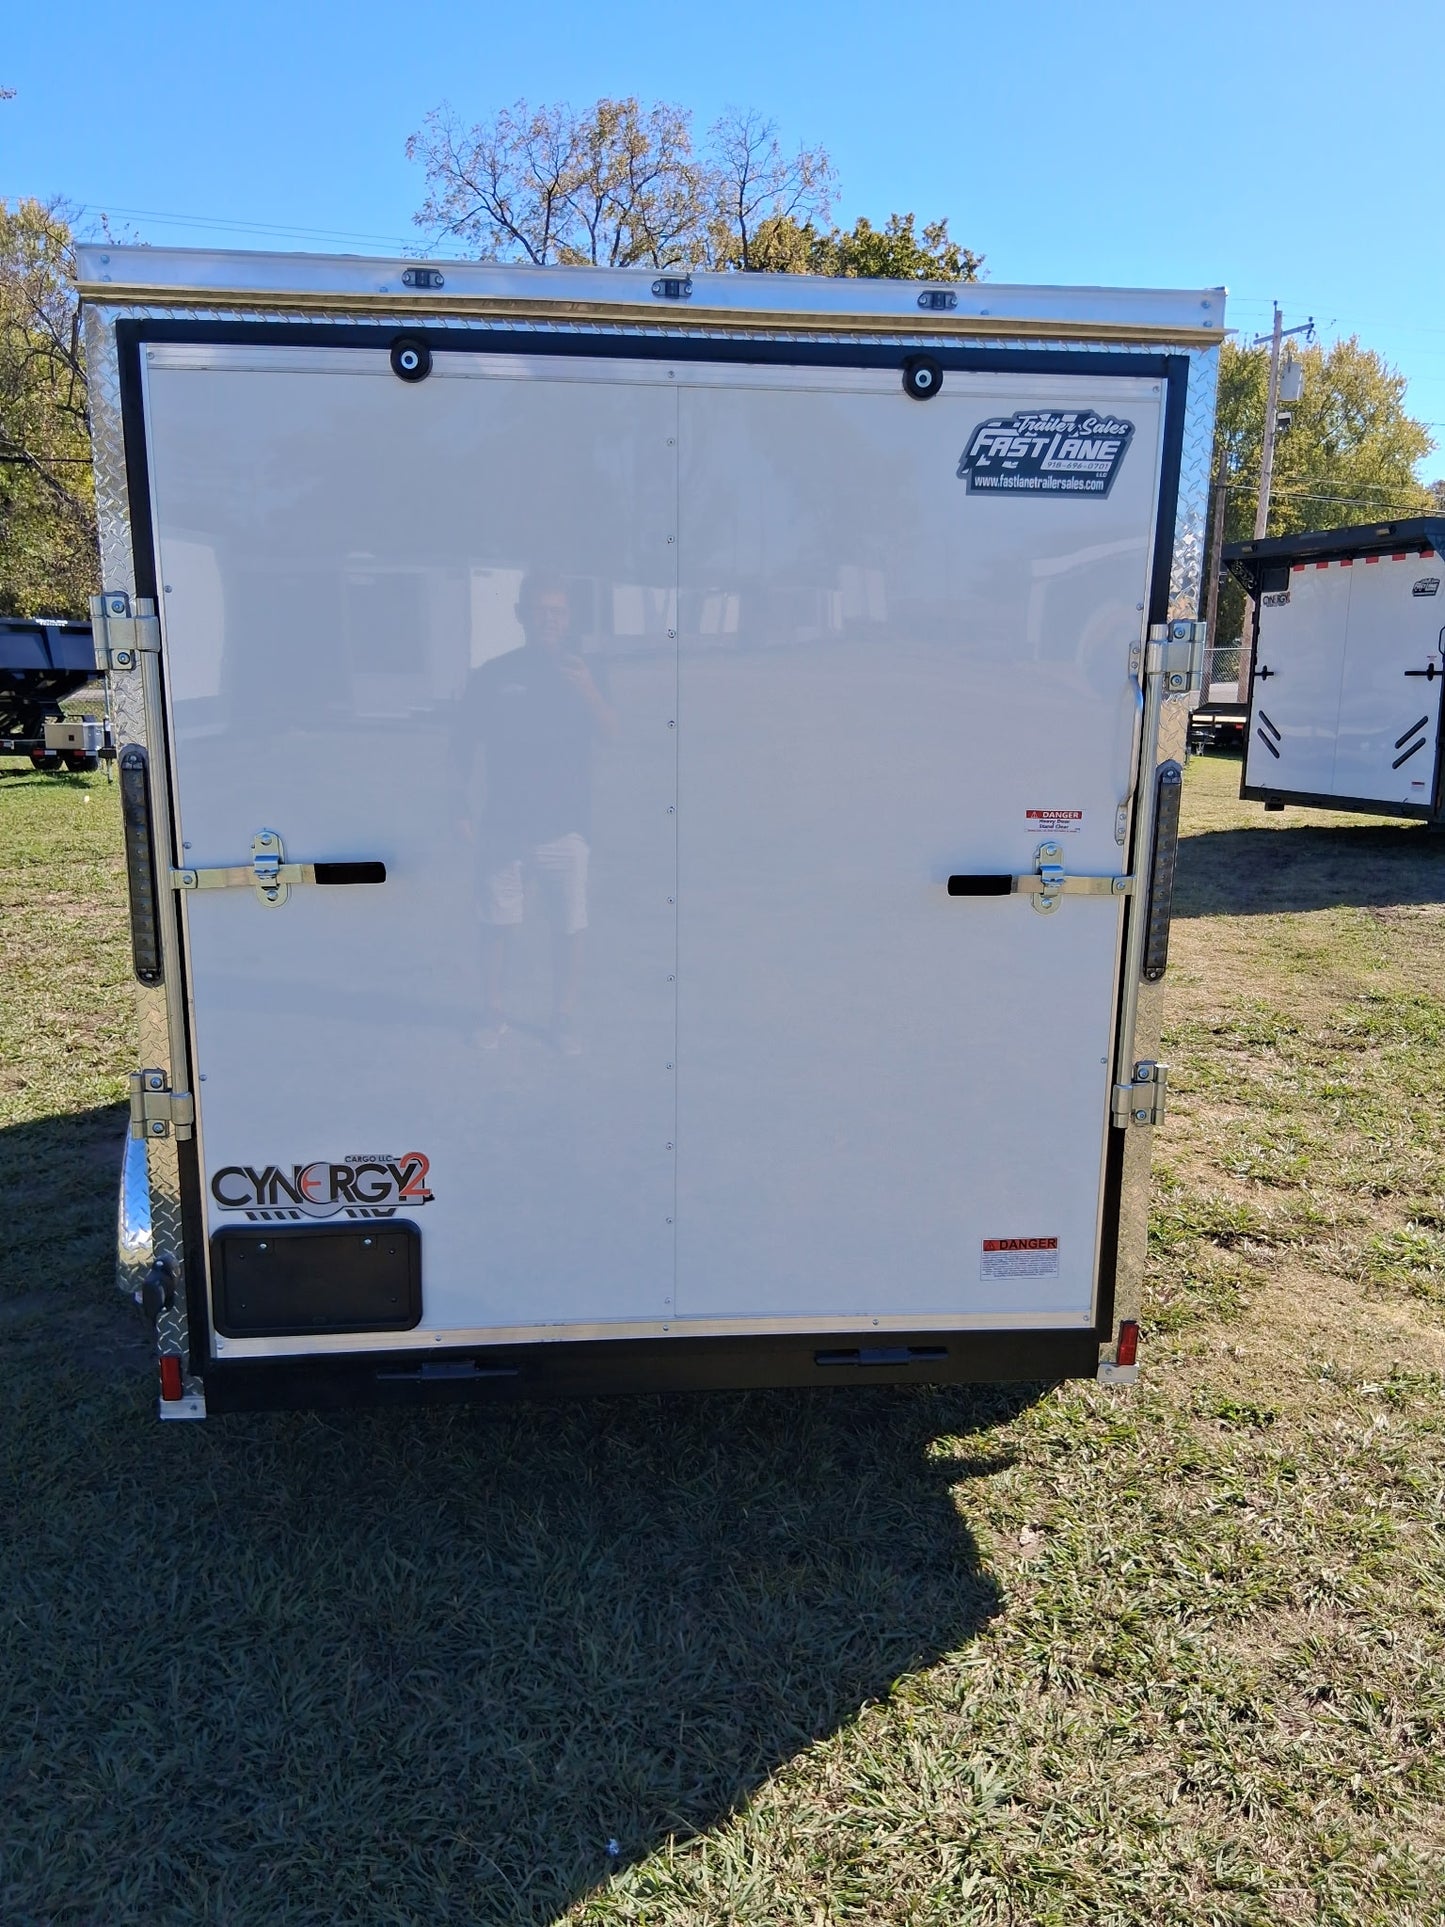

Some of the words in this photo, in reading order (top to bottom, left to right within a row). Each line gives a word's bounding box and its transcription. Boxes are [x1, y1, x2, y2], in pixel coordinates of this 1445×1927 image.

[1017, 415, 1077, 433] Trailer
[1078, 417, 1129, 435] Sales
[969, 428, 1050, 458] FAST
[1040, 433, 1121, 471] LANE
[1047, 461, 1109, 471] 918-696-0701
[974, 474, 1104, 491] www.fastlanetrailersales.com
[344, 1154, 377, 1163] CARGO
[378, 1154, 394, 1162] LLC
[999, 1239, 1056, 1250] DANGER
